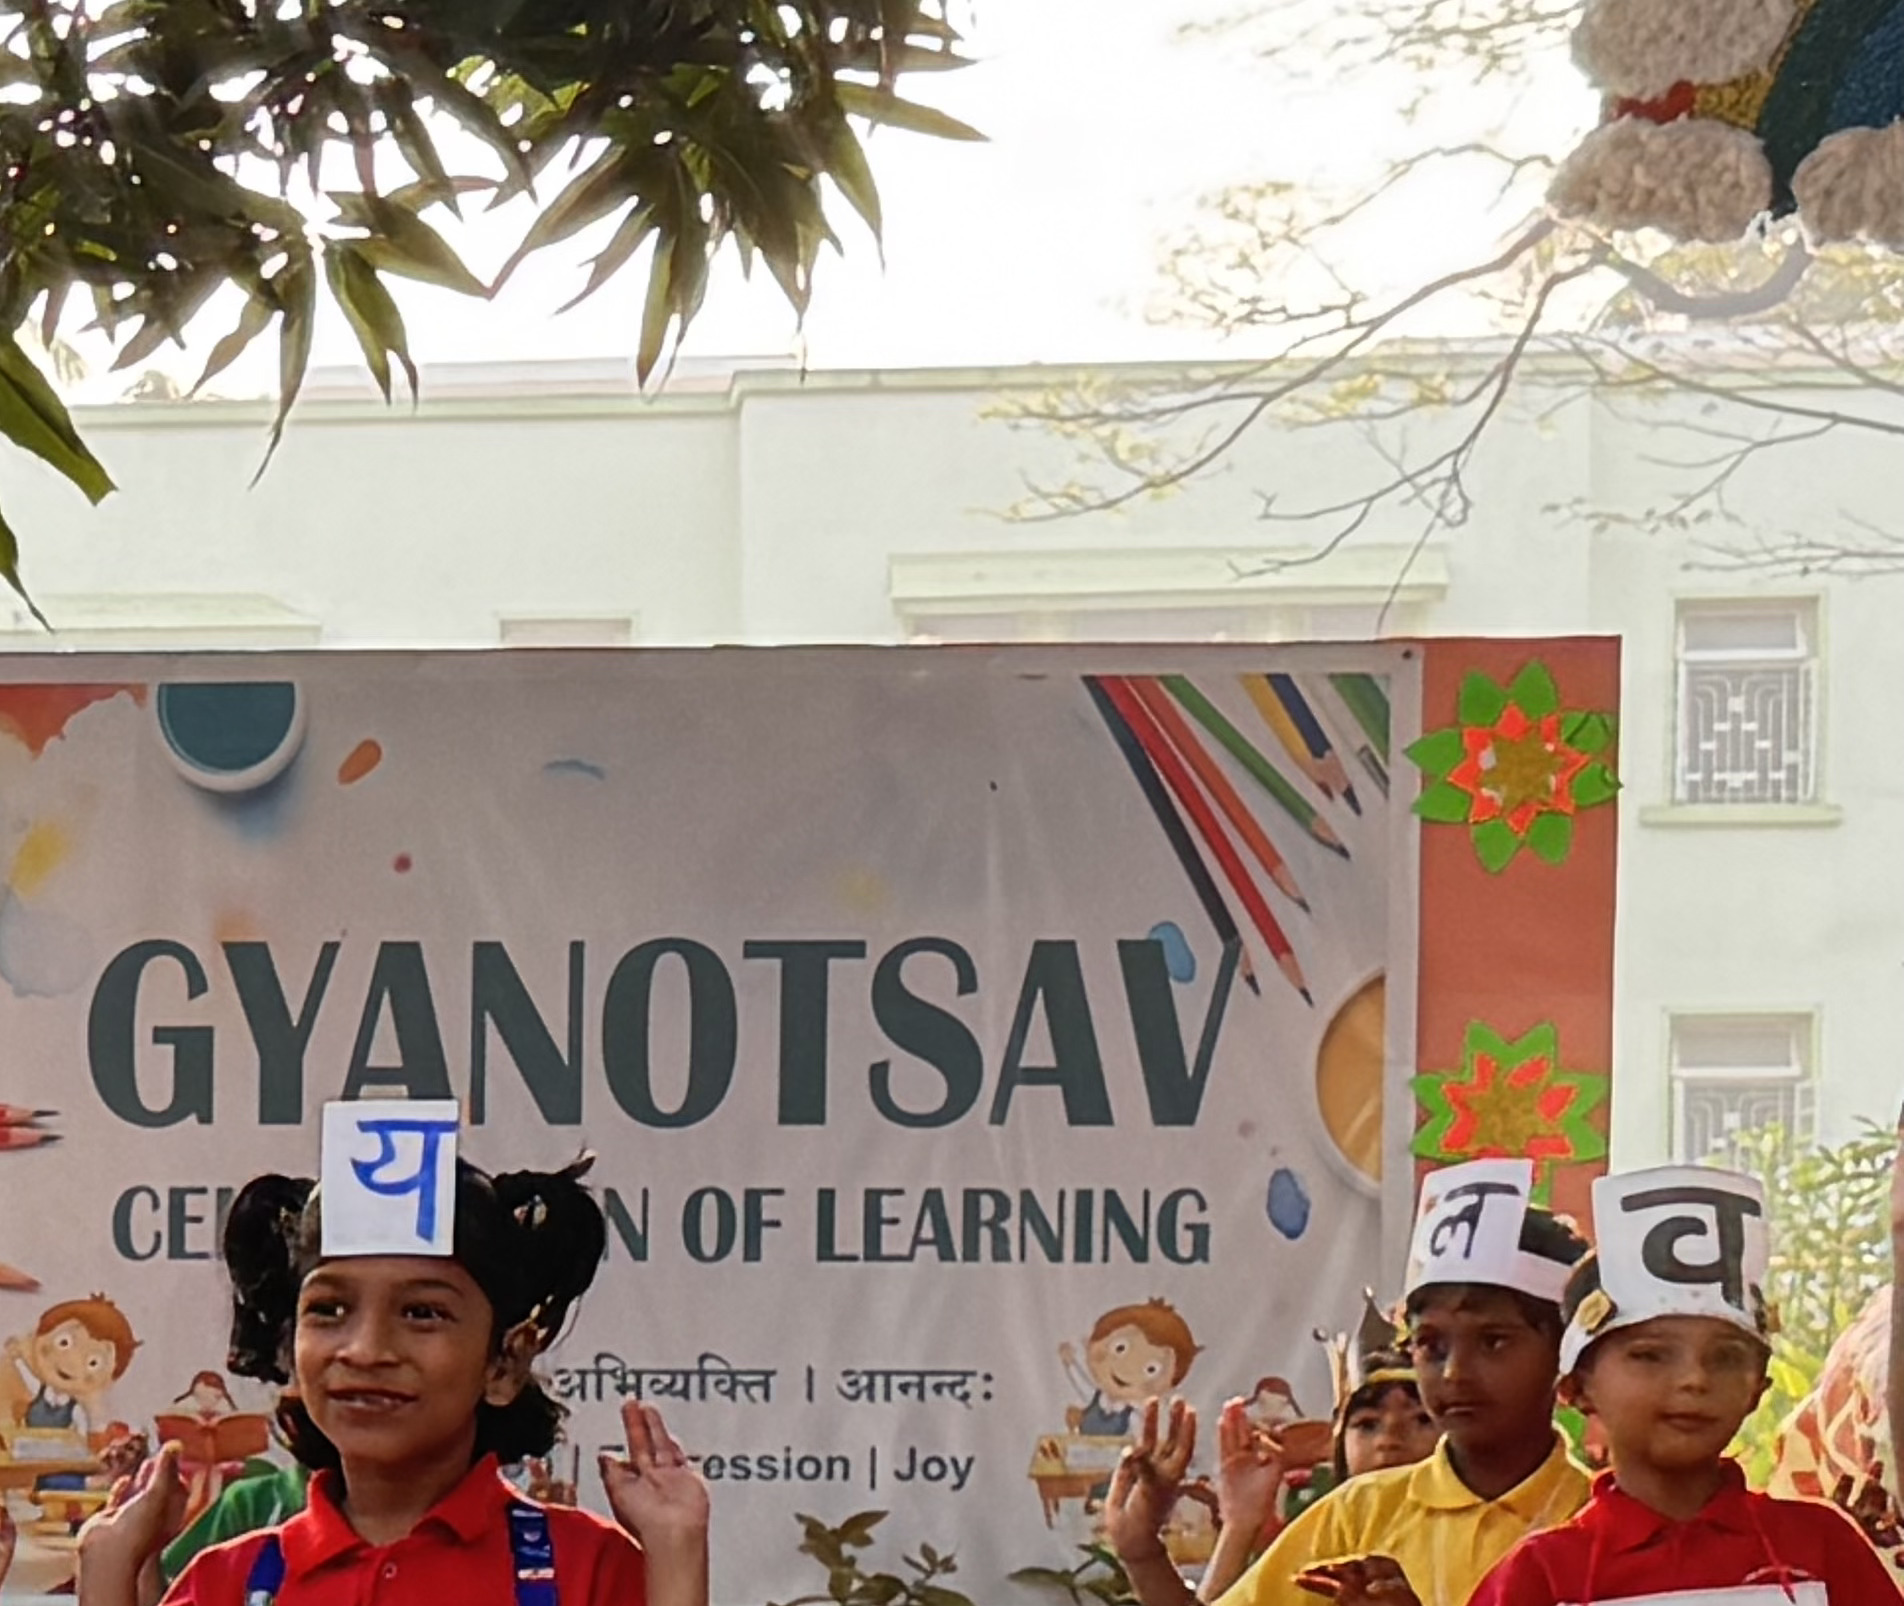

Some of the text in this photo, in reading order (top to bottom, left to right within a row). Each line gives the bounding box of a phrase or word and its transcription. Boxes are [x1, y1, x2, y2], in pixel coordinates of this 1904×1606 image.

[88, 936, 1238, 1130] GYANOTSAV
[350, 1119, 458, 1242] य
[682, 1185, 782, 1263] OF
[812, 1185, 1214, 1265] LEARNING
[1430, 1181, 1521, 1260] ल
[1620, 1186, 1762, 1313] व
[599, 1445, 850, 1482] ession
[892, 1447, 975, 1491] Joy
